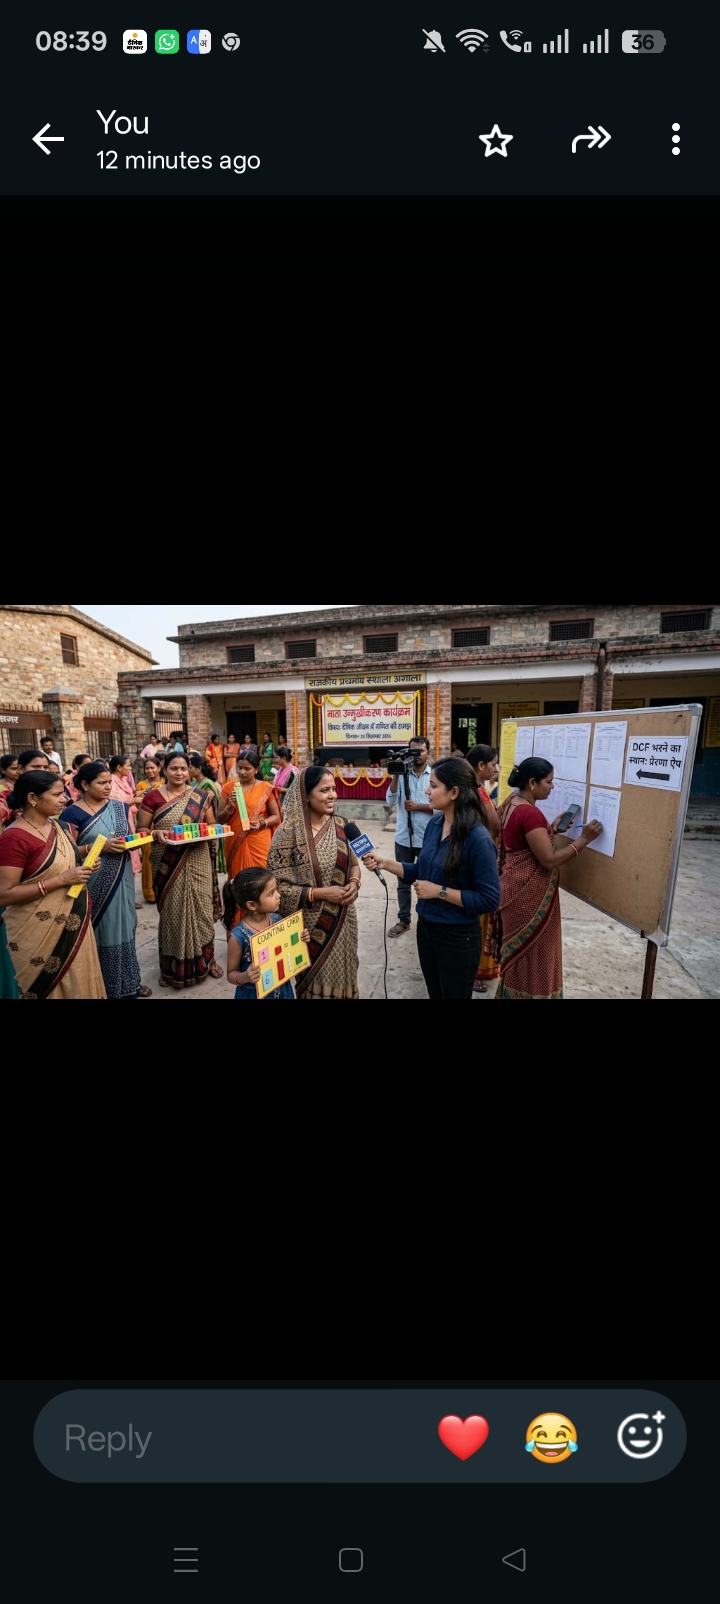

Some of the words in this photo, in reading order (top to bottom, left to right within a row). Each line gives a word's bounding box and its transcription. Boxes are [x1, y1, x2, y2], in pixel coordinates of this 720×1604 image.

[383, 704, 411, 718] कार्यक्रम
[632, 743, 650, 752] DCF
[652, 741, 668, 753] भरने
[670, 744, 681, 753] का
[629, 756, 647, 765] स्थान:
[649, 755, 668, 767] प्रेरणा
[670, 757, 682, 769] ऐप
[257, 923, 285, 945] COUNTING
[286, 915, 300, 928] CARD
[265, 974, 270, 985] 6
